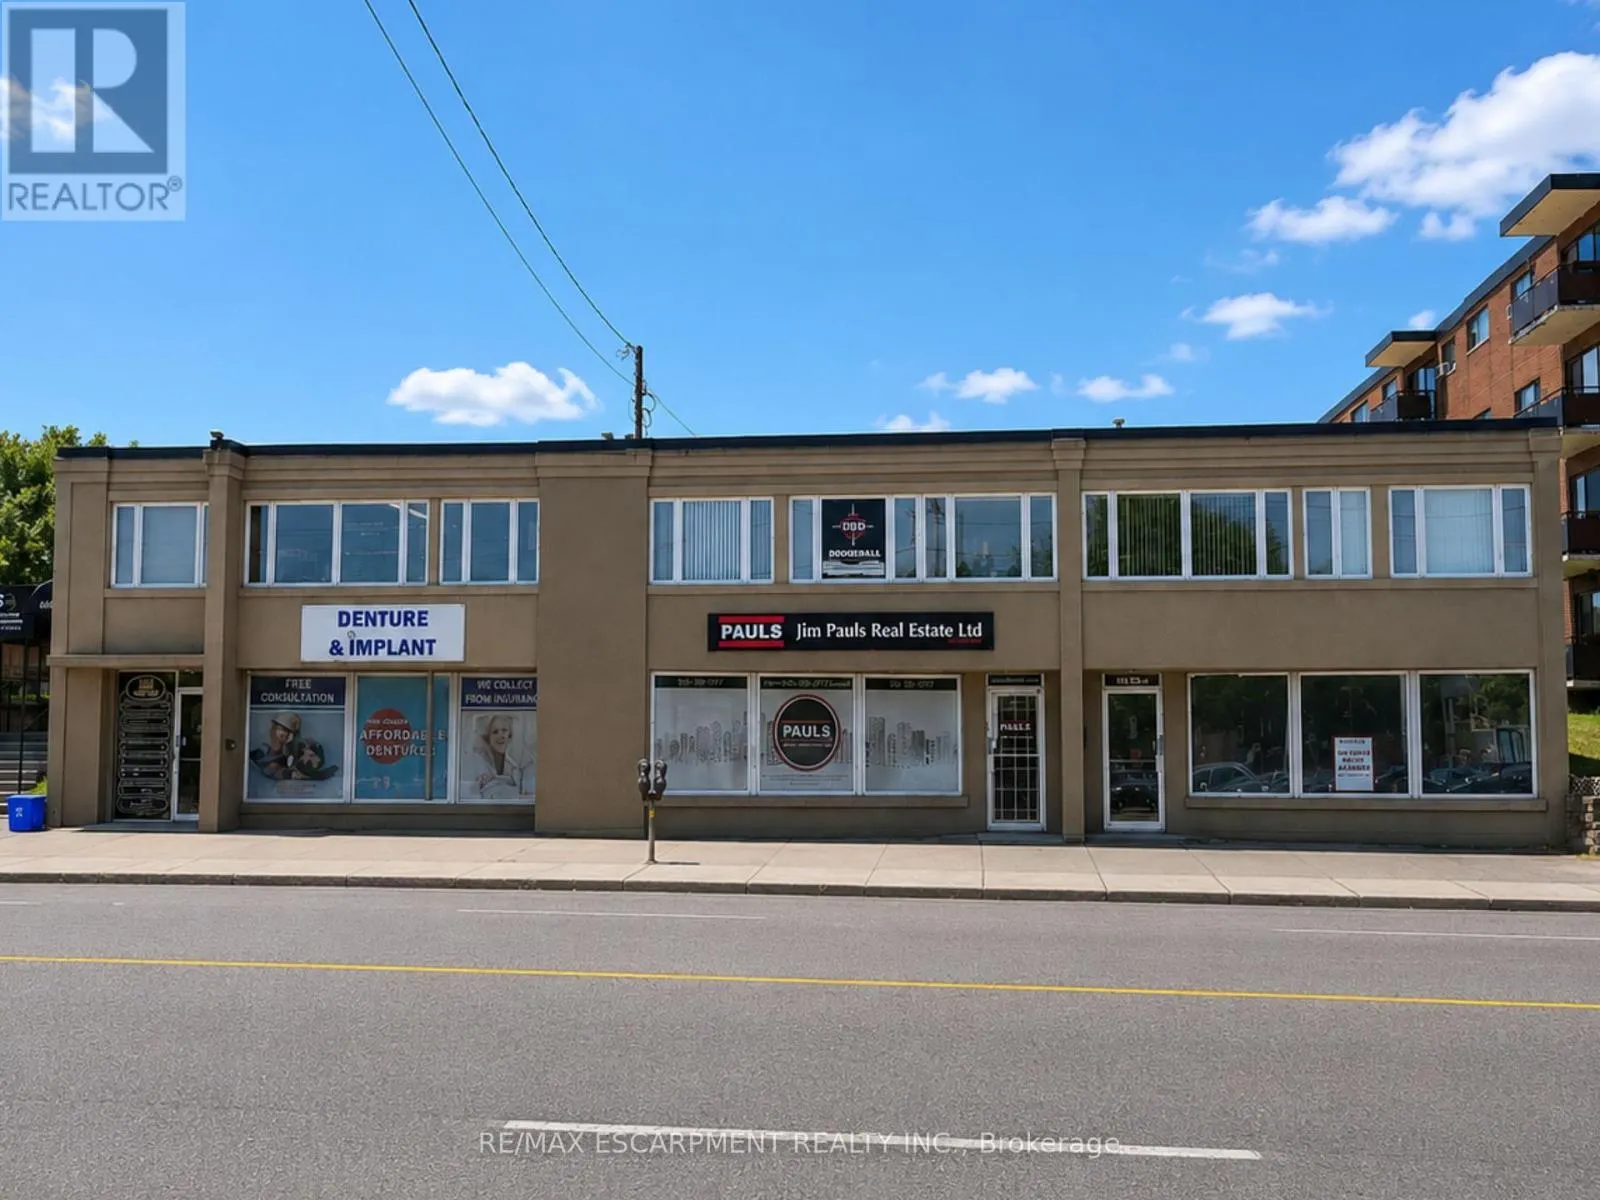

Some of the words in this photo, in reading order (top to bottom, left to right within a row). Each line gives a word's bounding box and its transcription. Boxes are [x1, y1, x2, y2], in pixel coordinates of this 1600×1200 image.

[337, 610, 429, 627] DENTURE
[720, 623, 783, 640] PAULS
[795, 622, 822, 641] Jim
[826, 622, 867, 638] Pauls
[871, 621, 904, 638] Real
[908, 621, 954, 638] Estate
[958, 621, 983, 638] Ltd
[328, 639, 344, 656] &
[349, 639, 437, 656] IMPLANT
[782, 724, 831, 738] PAULS
